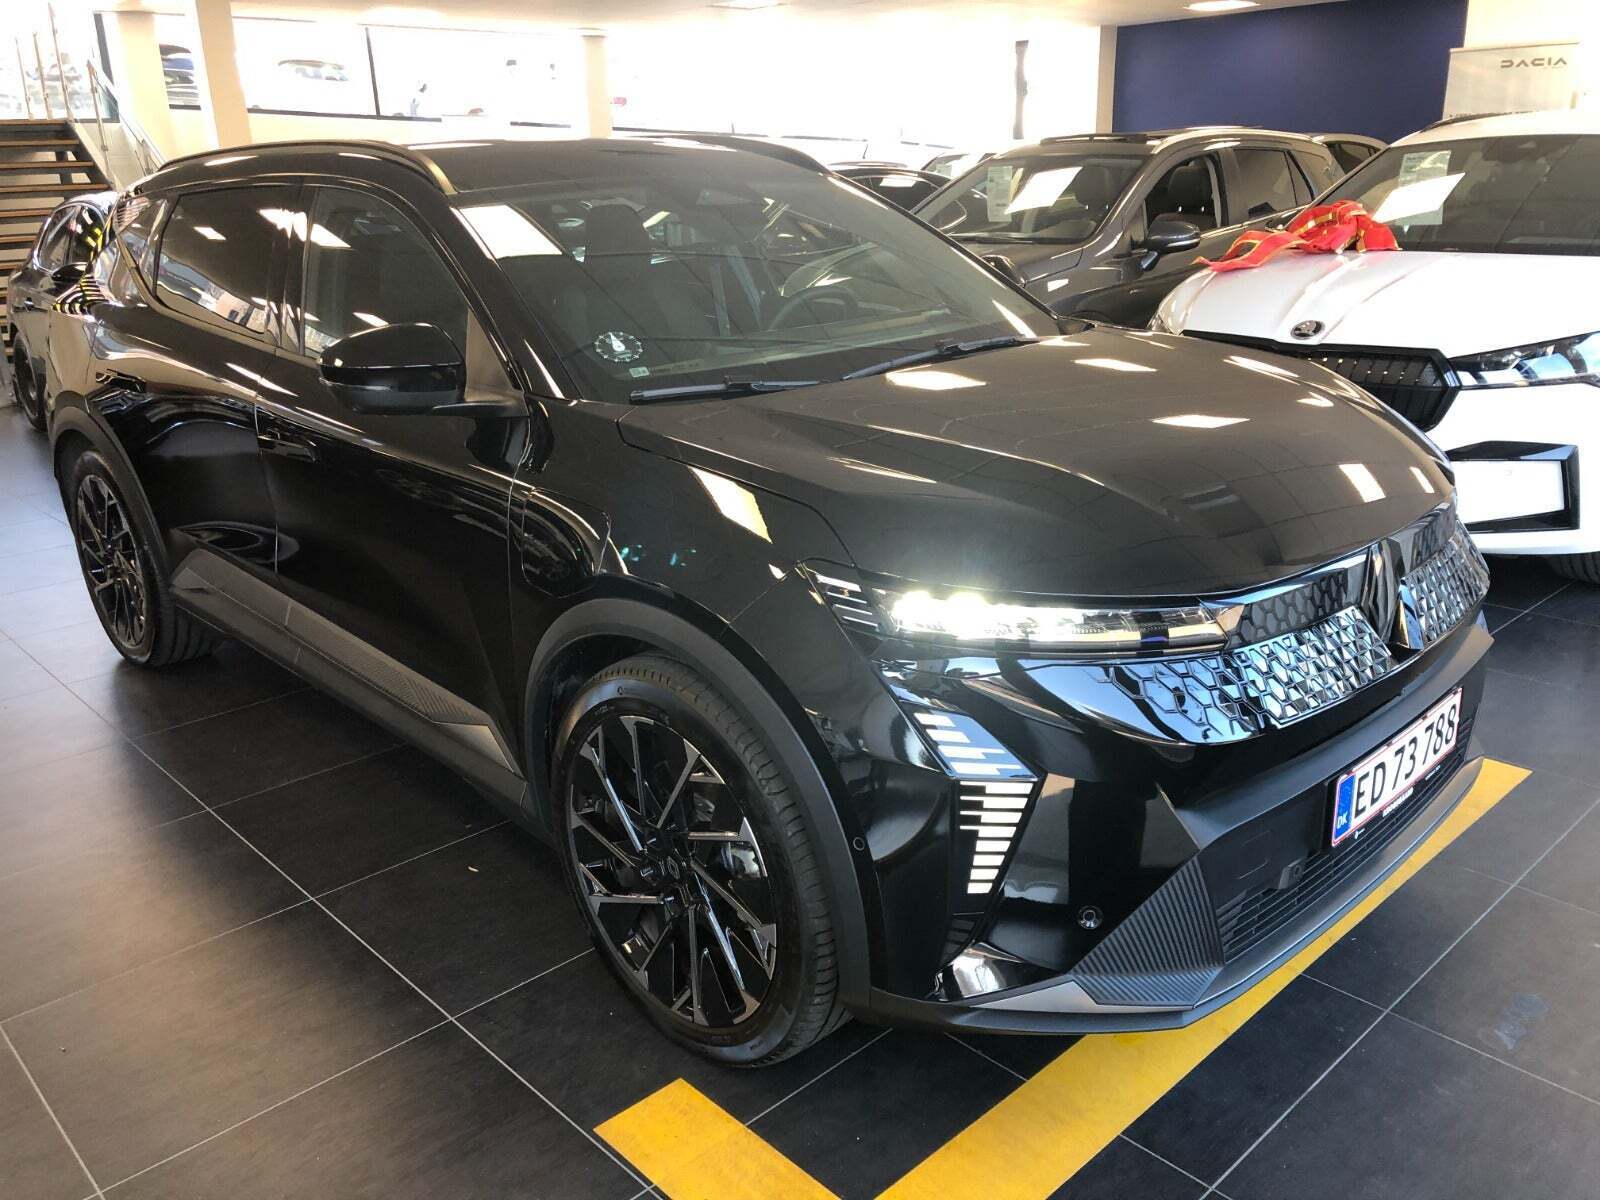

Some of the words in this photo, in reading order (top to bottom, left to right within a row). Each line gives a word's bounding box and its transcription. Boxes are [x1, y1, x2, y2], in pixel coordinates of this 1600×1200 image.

[1500, 57, 1568, 69] DACIA
[1354, 761, 1386, 818] ED
[1391, 736, 1418, 790] 73
[1422, 703, 1457, 765] 788
[1336, 813, 1348, 829] DK
